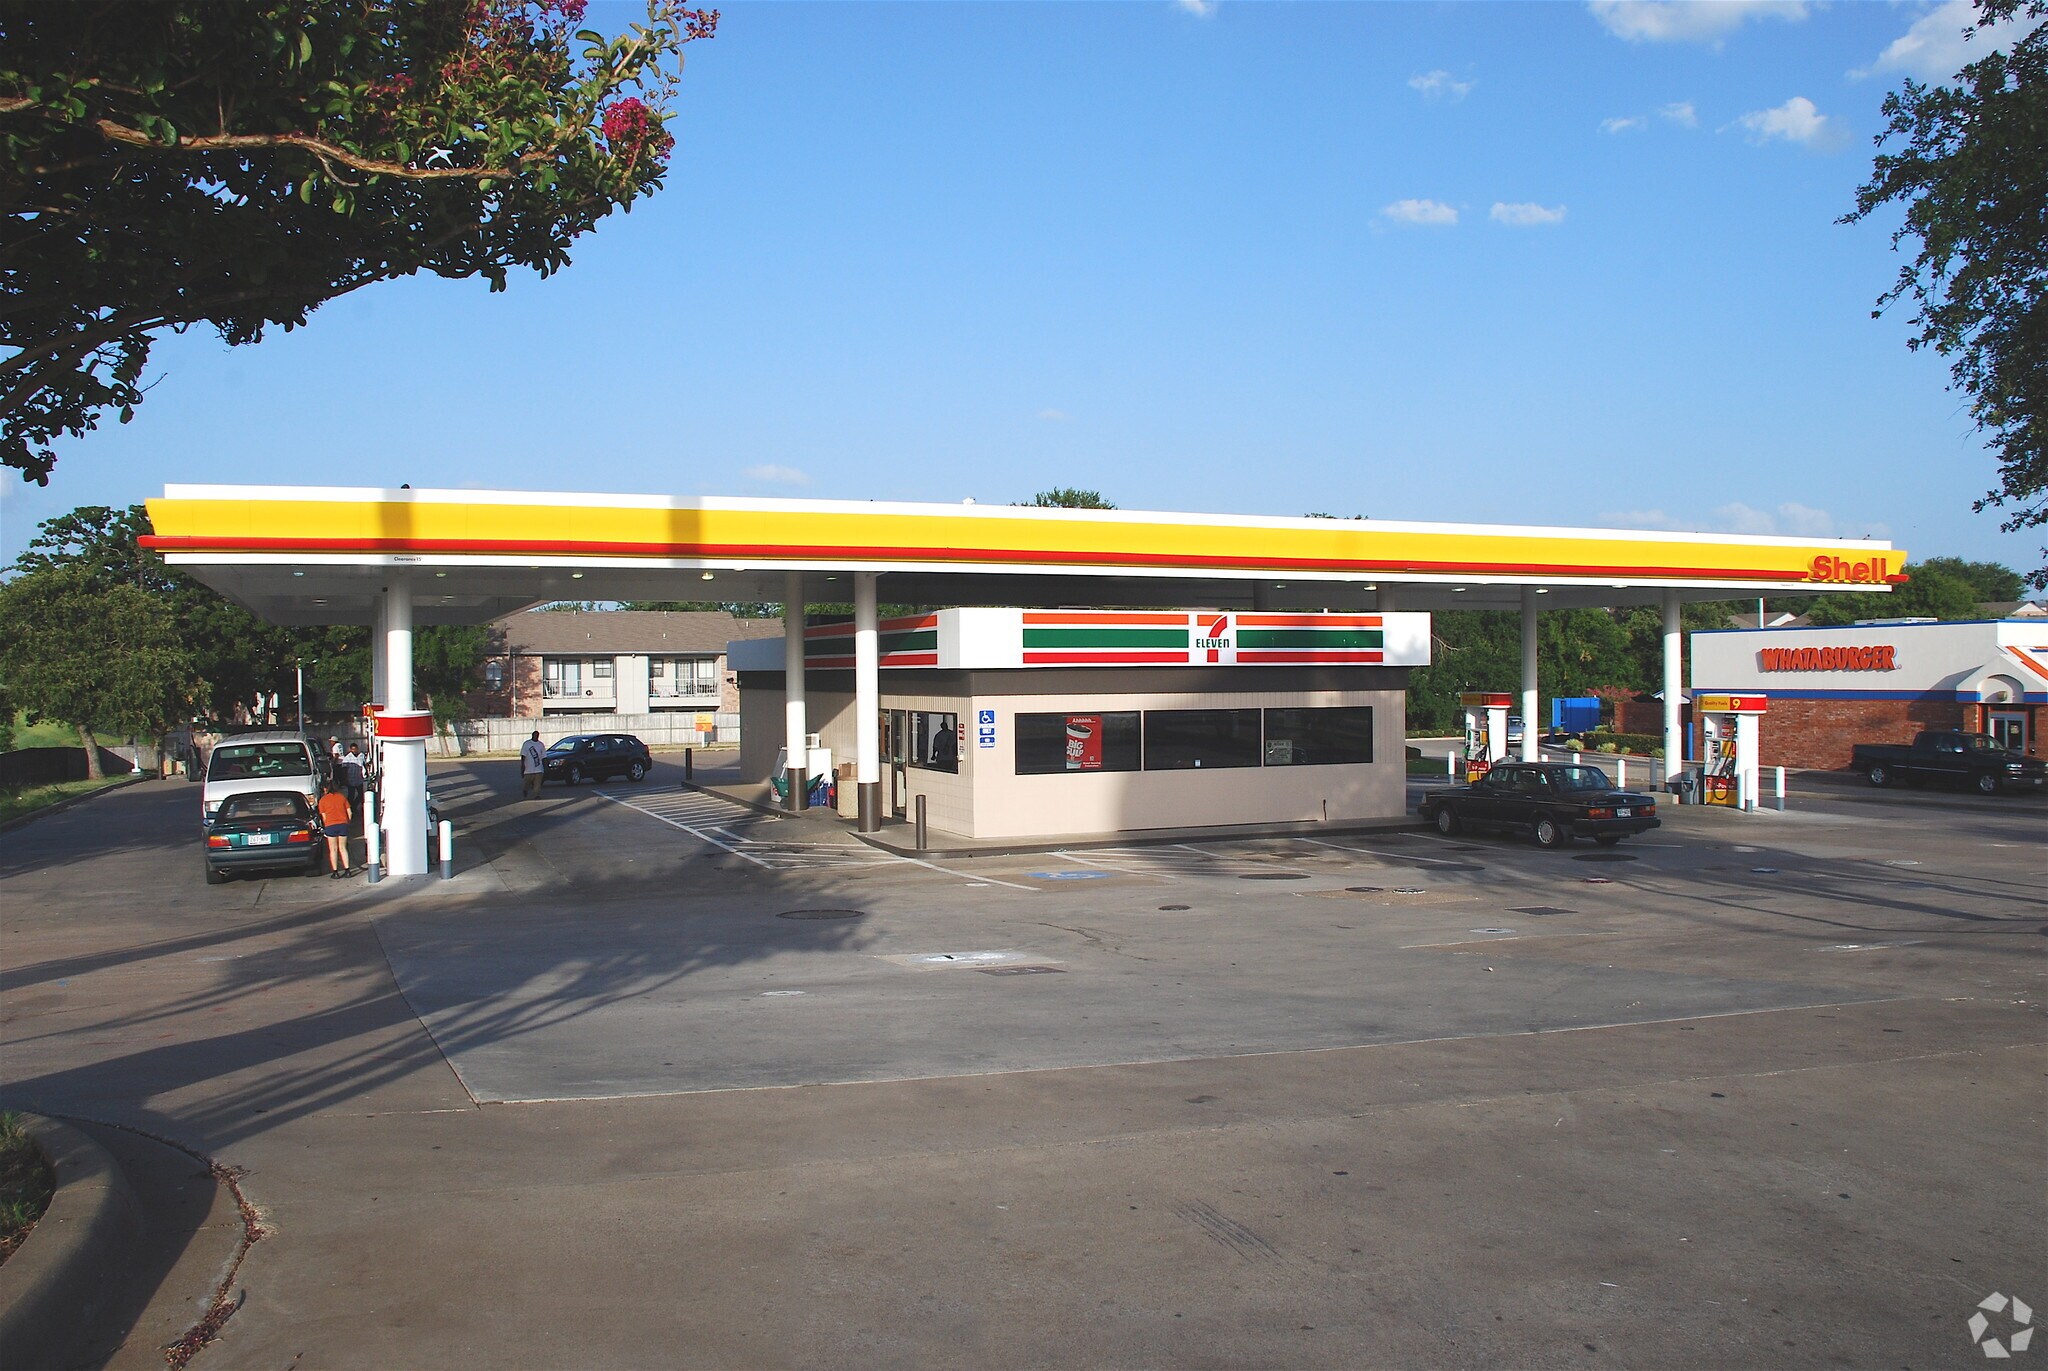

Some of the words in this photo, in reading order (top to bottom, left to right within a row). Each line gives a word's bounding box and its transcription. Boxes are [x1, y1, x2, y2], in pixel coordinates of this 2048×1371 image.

[1811, 555, 1887, 580] Shell
[1197, 615, 1227, 663] 7
[1760, 646, 1897, 671] WHATABURGER
[1732, 698, 1741, 709] 9
